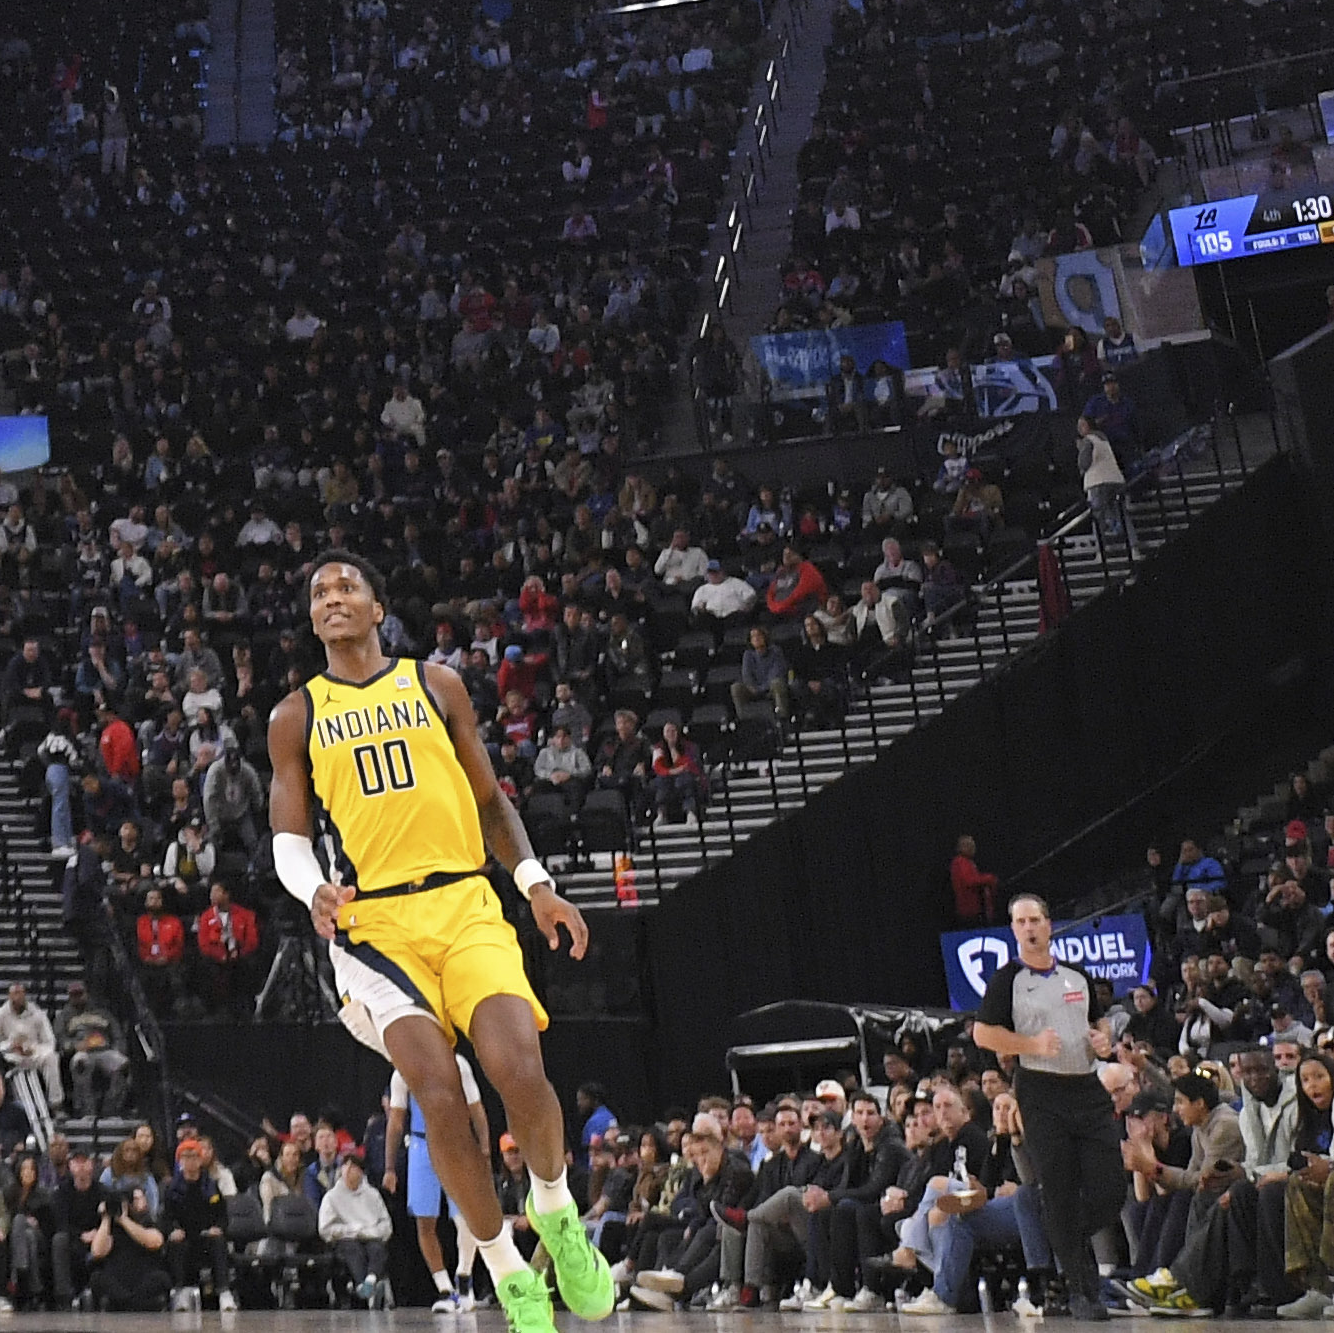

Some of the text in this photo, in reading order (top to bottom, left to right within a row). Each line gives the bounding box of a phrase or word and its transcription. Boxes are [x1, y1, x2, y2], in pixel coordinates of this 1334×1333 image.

[1292, 195, 1332, 222] 1:30
[1196, 230, 1232, 256] 105
[316, 699, 433, 749] INDIANA
[353, 738, 416, 798] 00
[1050, 932, 1135, 963] NDUEL
